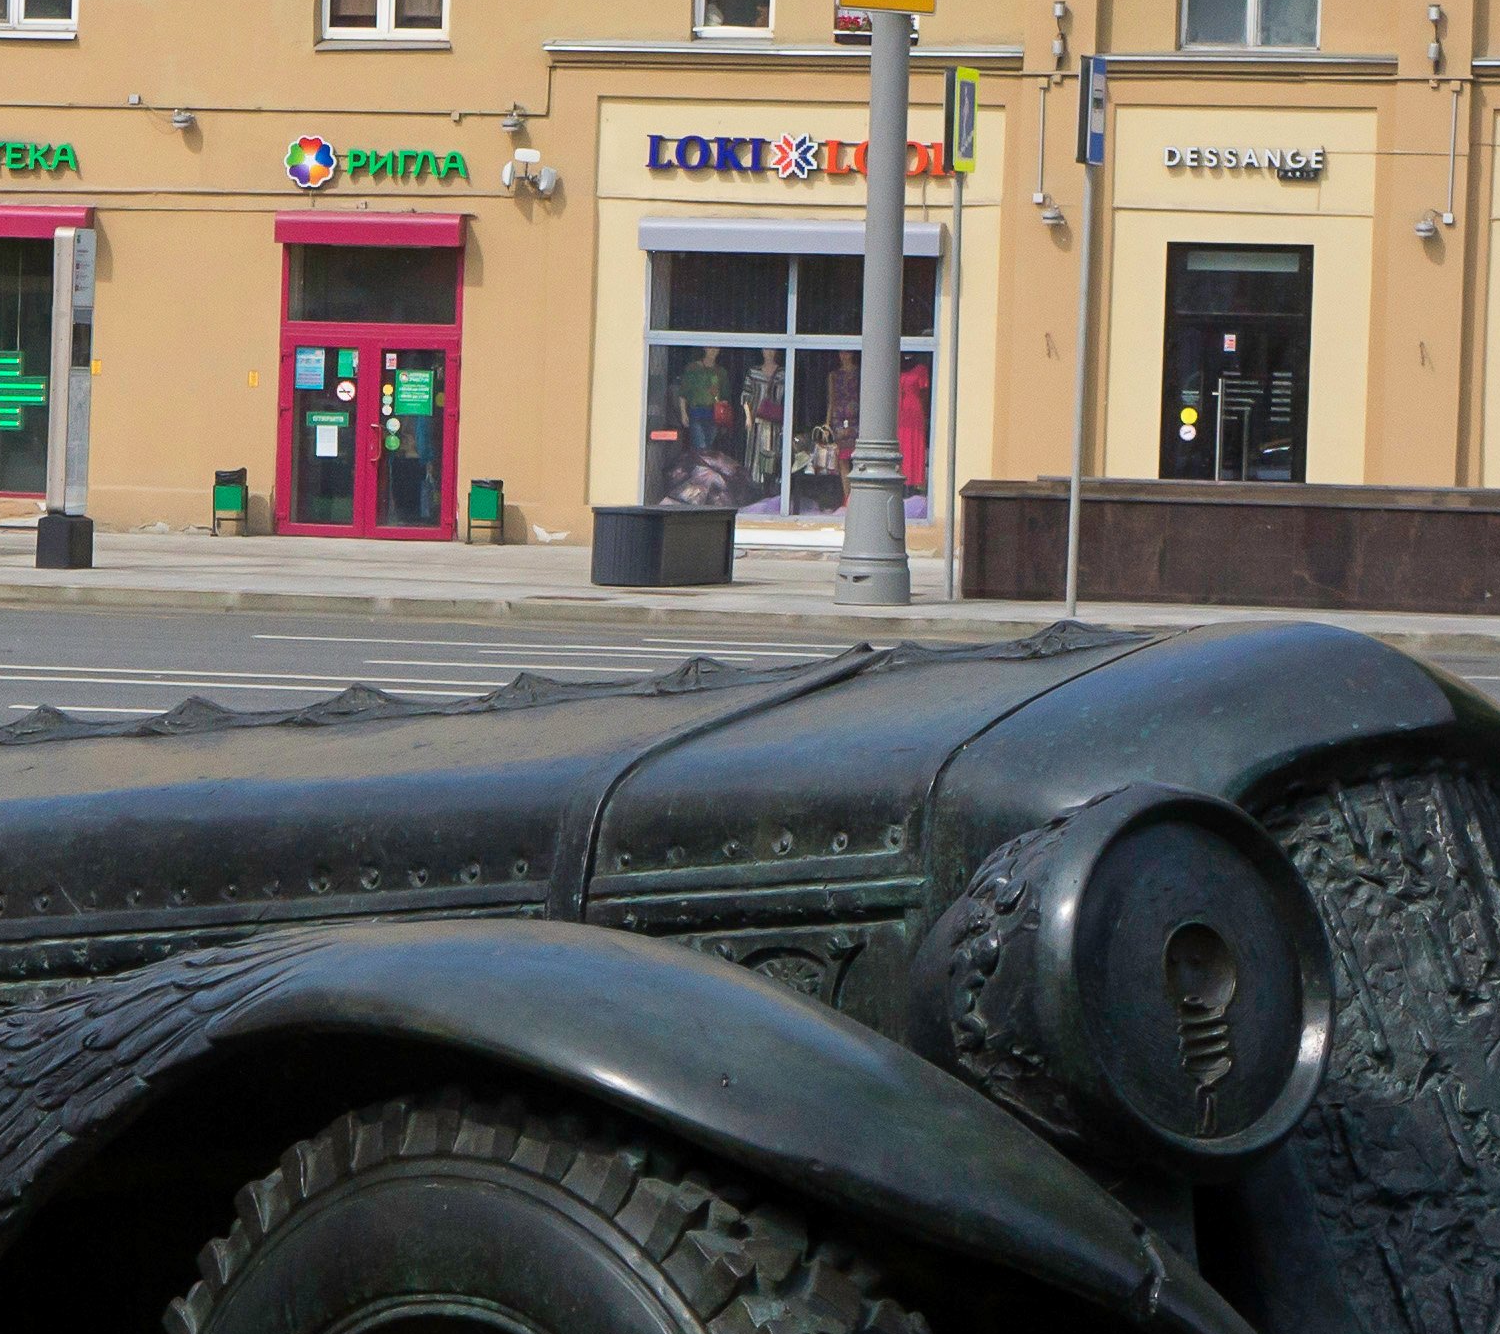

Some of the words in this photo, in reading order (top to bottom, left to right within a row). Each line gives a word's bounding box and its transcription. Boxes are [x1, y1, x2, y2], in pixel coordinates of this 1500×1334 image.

[346, 149, 470, 179] РИГЛА
[646, 134, 767, 172] LOKI
[1164, 146, 1324, 169] DESSANGE
[1278, 170, 1316, 179] PARIS
